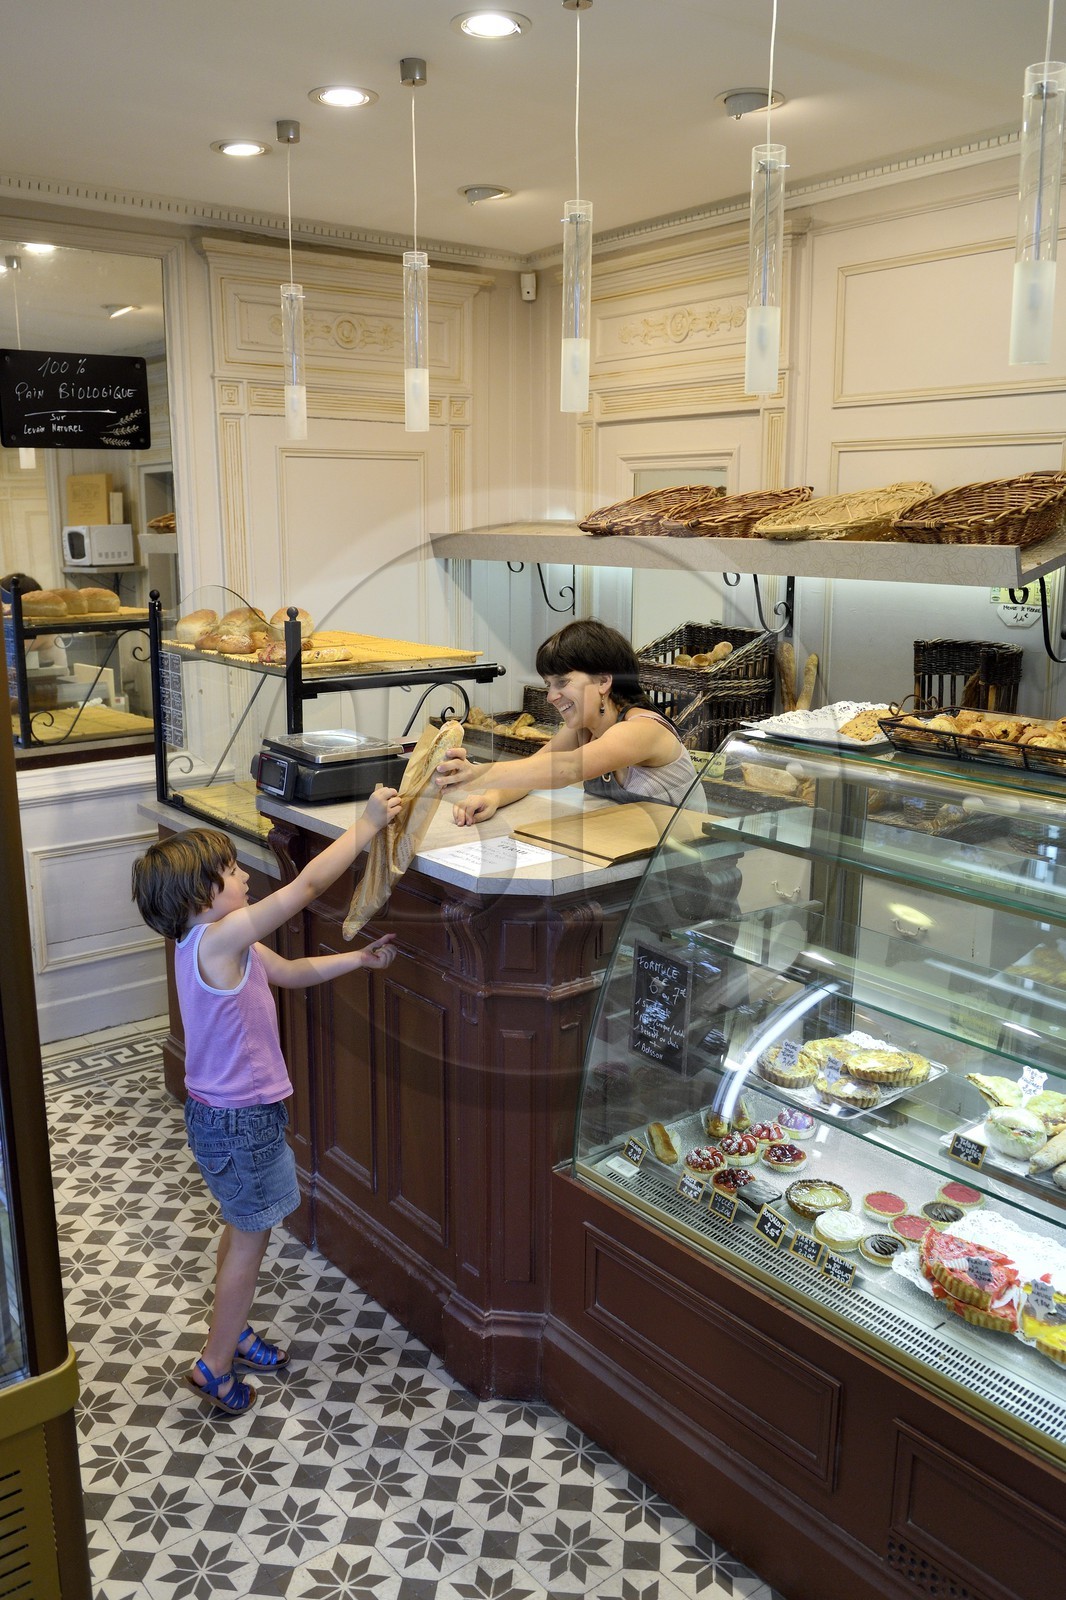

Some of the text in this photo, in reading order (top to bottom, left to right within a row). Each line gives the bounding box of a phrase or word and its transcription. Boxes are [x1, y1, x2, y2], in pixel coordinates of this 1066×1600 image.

[38, 357, 87, 378] 100 %
[637, 955, 680, 979] FORMULE
[797, 1234, 816, 1248] TARTE
